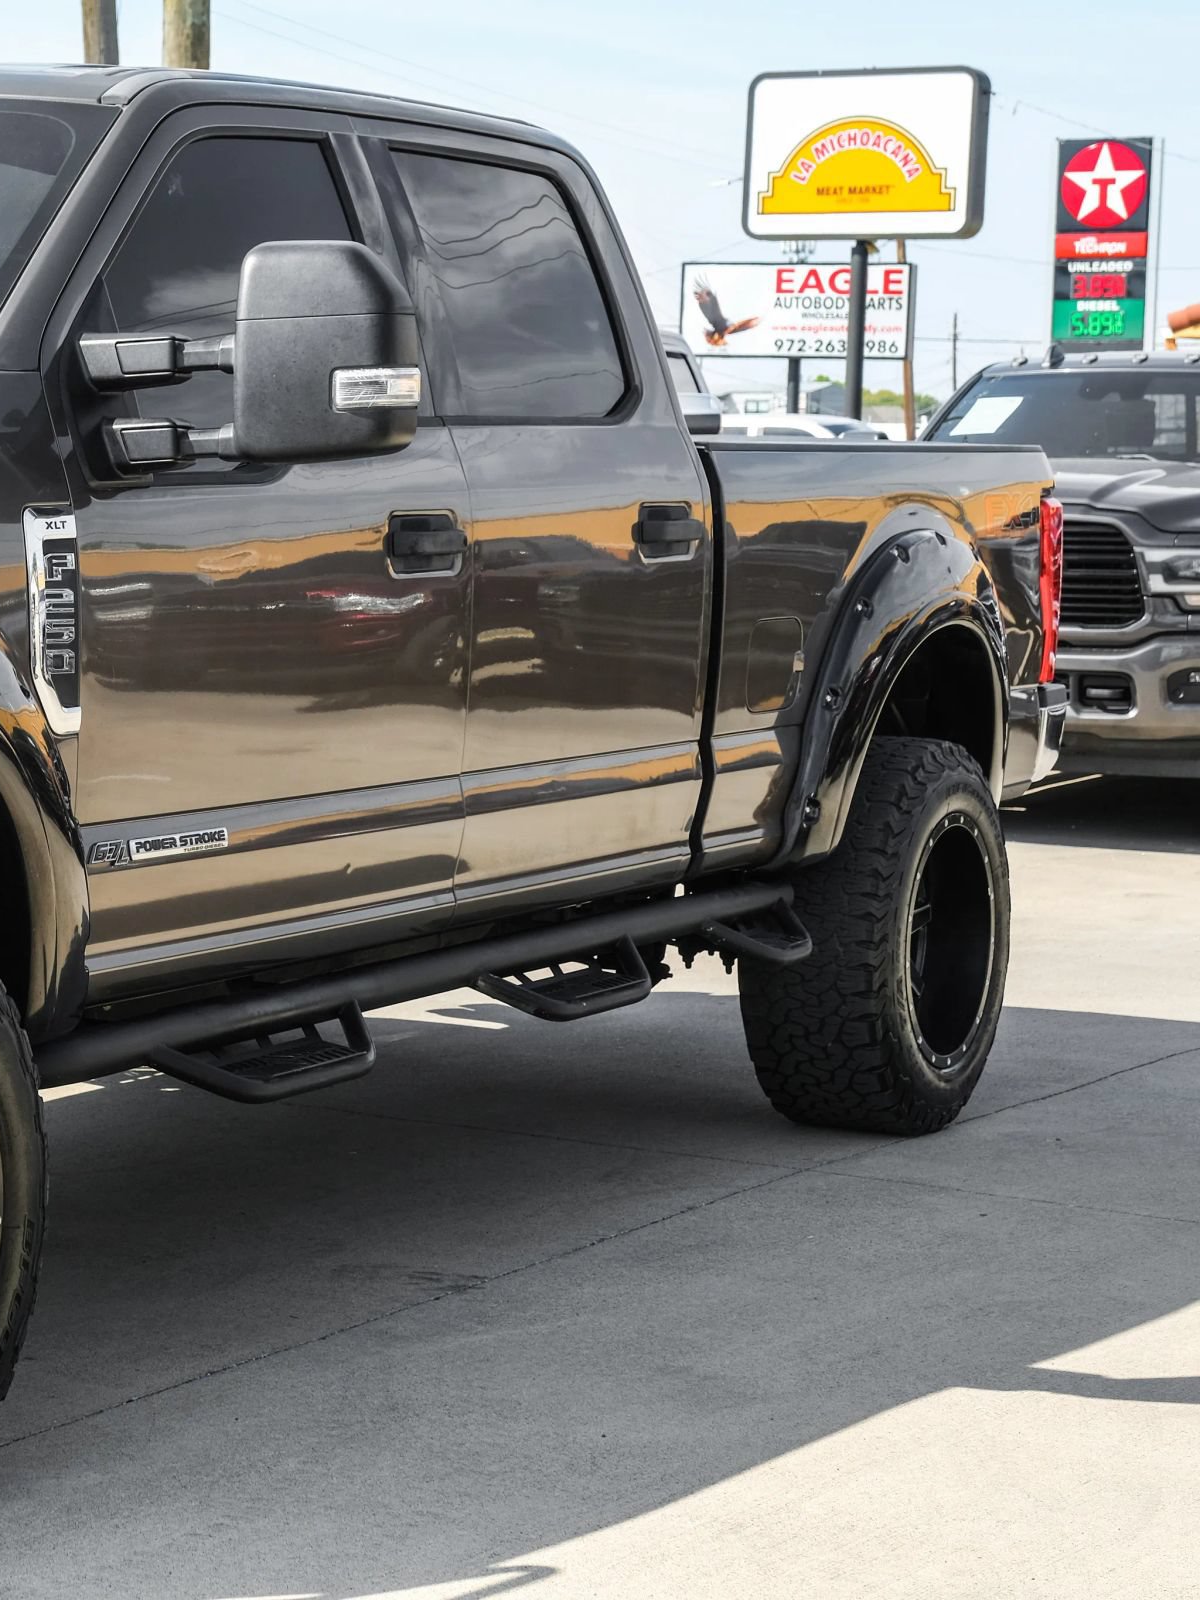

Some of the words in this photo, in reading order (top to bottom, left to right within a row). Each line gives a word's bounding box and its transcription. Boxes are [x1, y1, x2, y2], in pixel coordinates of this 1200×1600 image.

[792, 159, 814, 183] LA
[813, 131, 920, 180] MICHOACANA
[816, 186, 843, 196] MEAT
[848, 184, 889, 196] MARKET
[1066, 260, 1133, 272] UNLEADED
[864, 297, 903, 310] ARTS
[1076, 300, 1120, 311] DIESEL
[45, 520, 67, 530] XLT
[134, 837, 177, 854] POWER
[179, 829, 226, 847] STROKE
